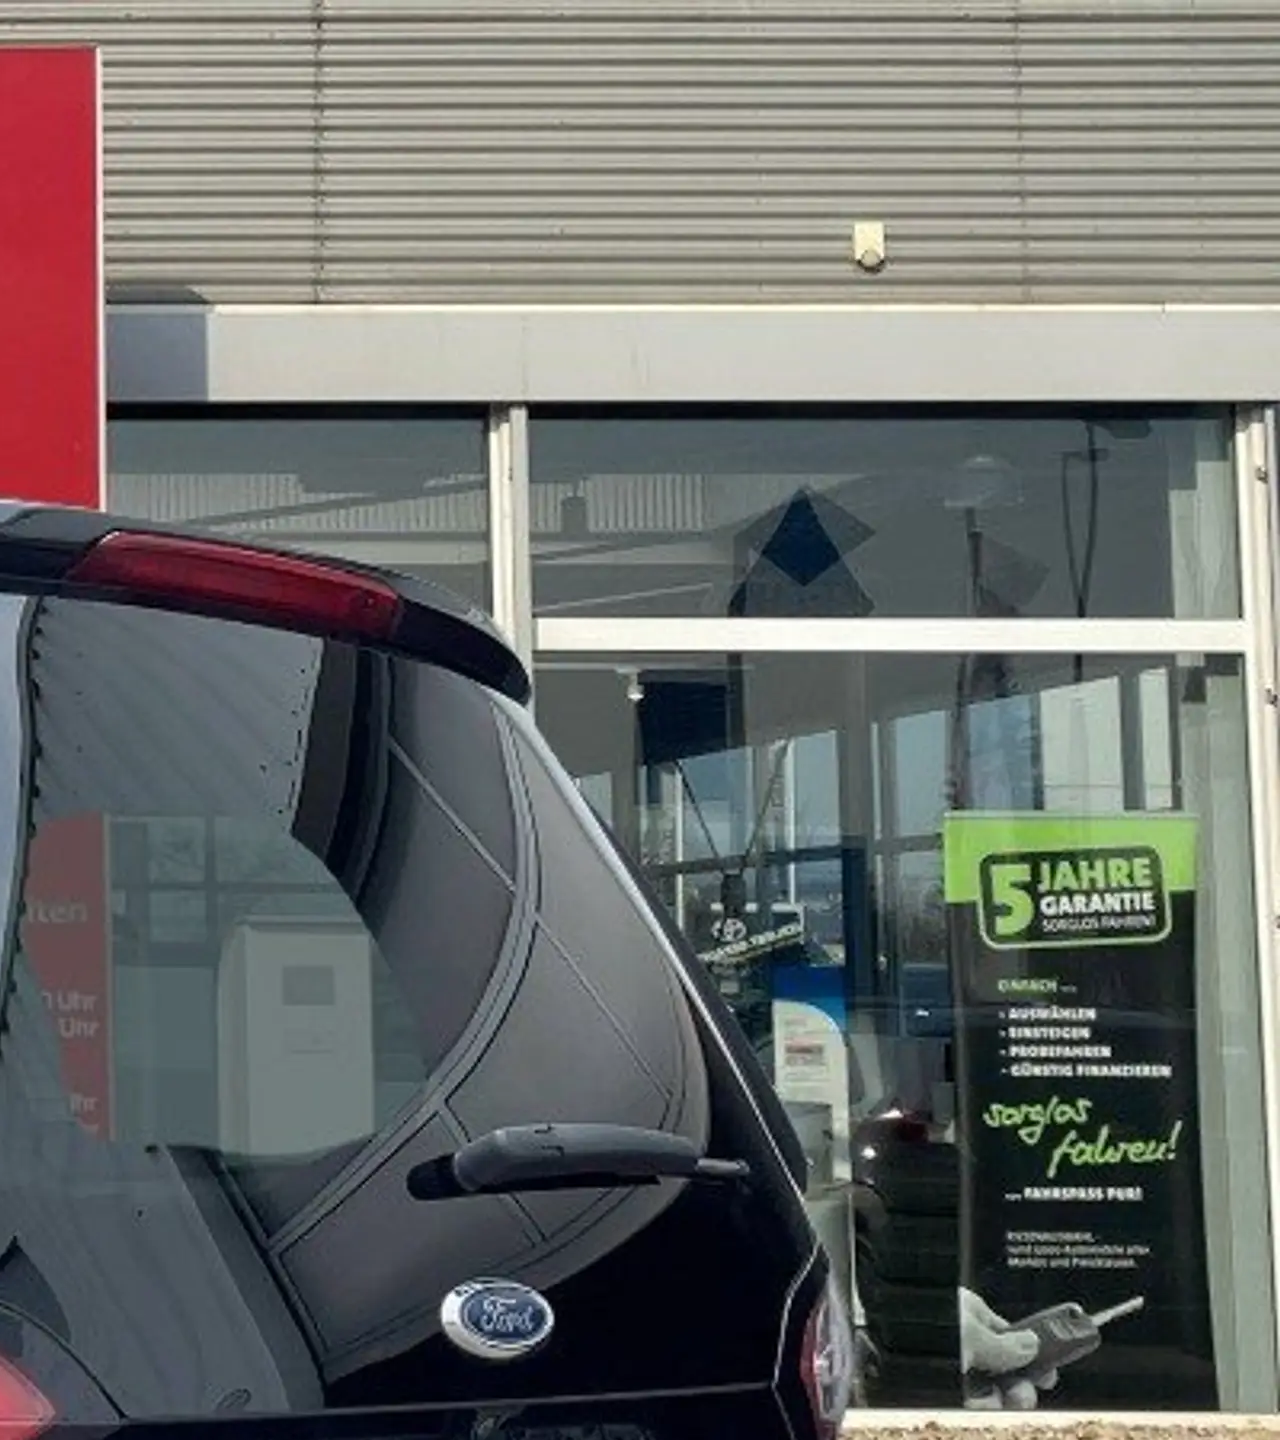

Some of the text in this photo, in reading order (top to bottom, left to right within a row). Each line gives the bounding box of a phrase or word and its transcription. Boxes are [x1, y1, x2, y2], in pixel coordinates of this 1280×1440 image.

[1037, 857, 1152, 893] JAHRE
[990, 863, 1035, 936] 5
[1040, 891, 1156, 917] GARANTIE
[983, 1095, 1092, 1146] sorglos
[1047, 1120, 1182, 1179] fahren!
[481, 1296, 533, 1333] Ford
